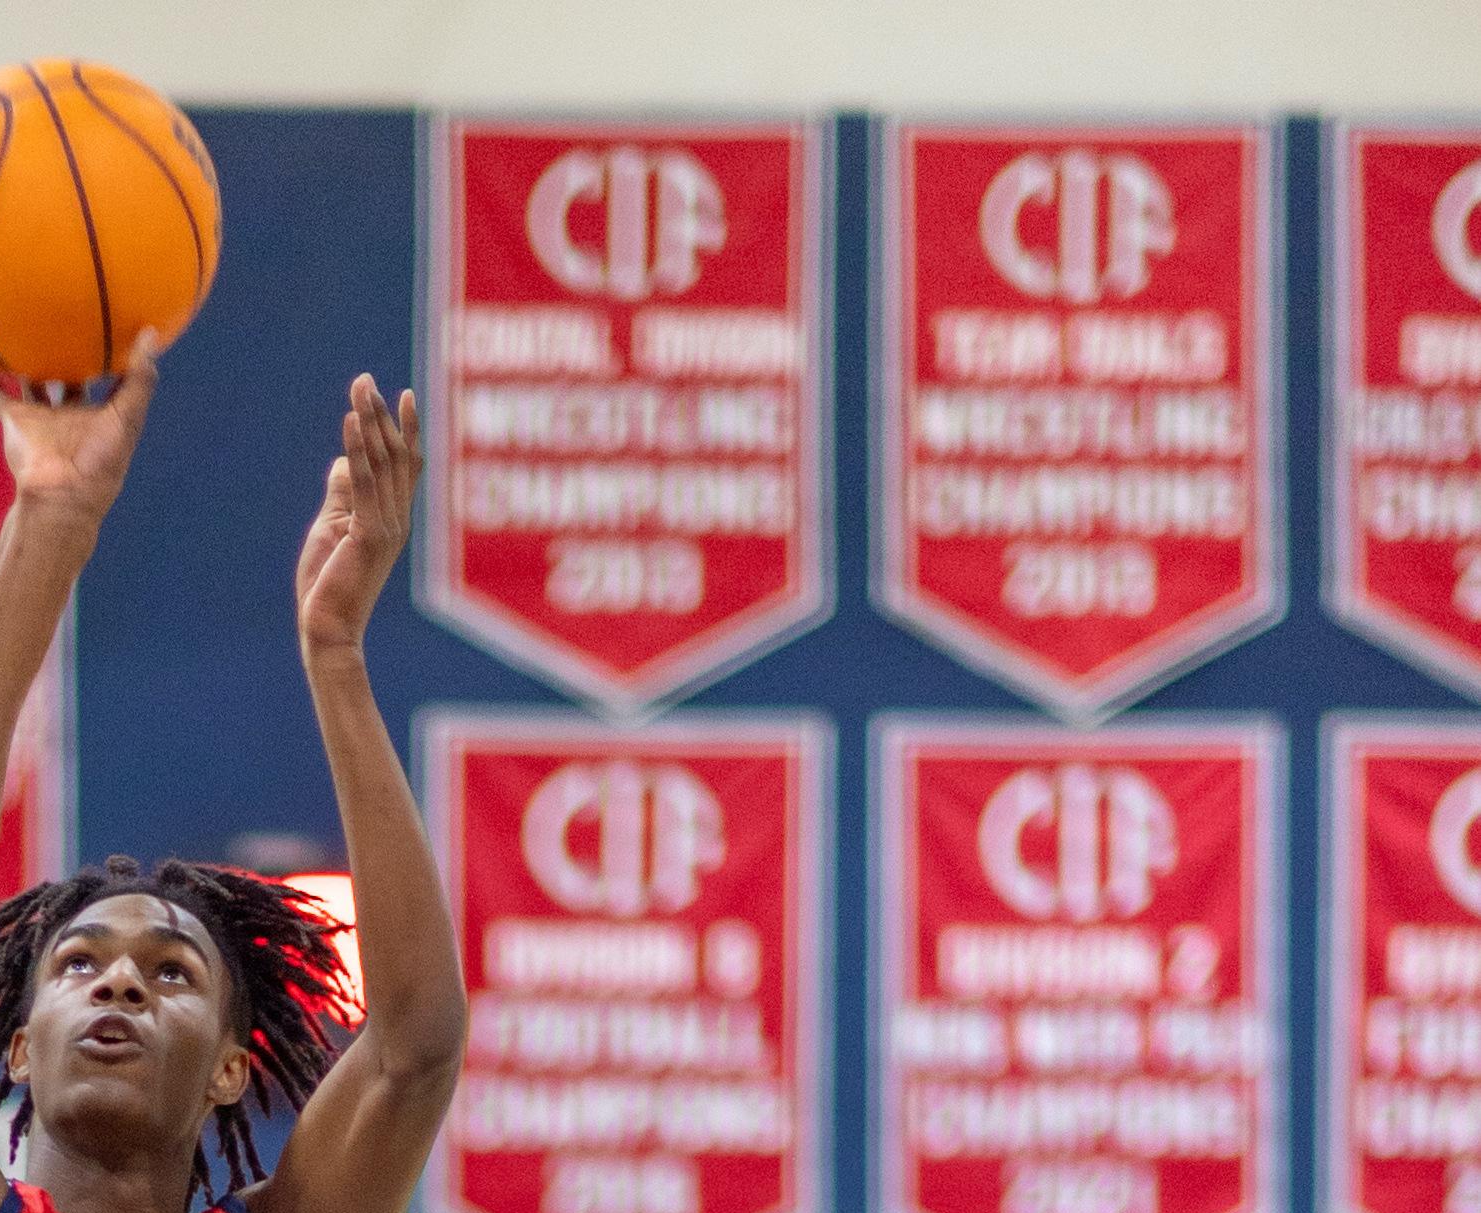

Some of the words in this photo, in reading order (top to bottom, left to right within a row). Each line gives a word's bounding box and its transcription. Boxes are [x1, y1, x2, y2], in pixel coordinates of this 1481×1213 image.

[525, 144, 728, 302] CIF
[978, 150, 1178, 304] CIF
[458, 384, 790, 446] WRESTLING
[914, 388, 1248, 454] WRESTLING
[454, 460, 793, 530] CHAMPIONS
[914, 464, 1246, 538] CHAMPIONS
[521, 762, 726, 917] CIF
[976, 764, 1178, 921] CIF
[470, 996, 768, 1070] FOOTBALL
[448, 1076, 792, 1152] CHAMPIONS
[910, 1080, 1250, 1158] CHAMPIONS
